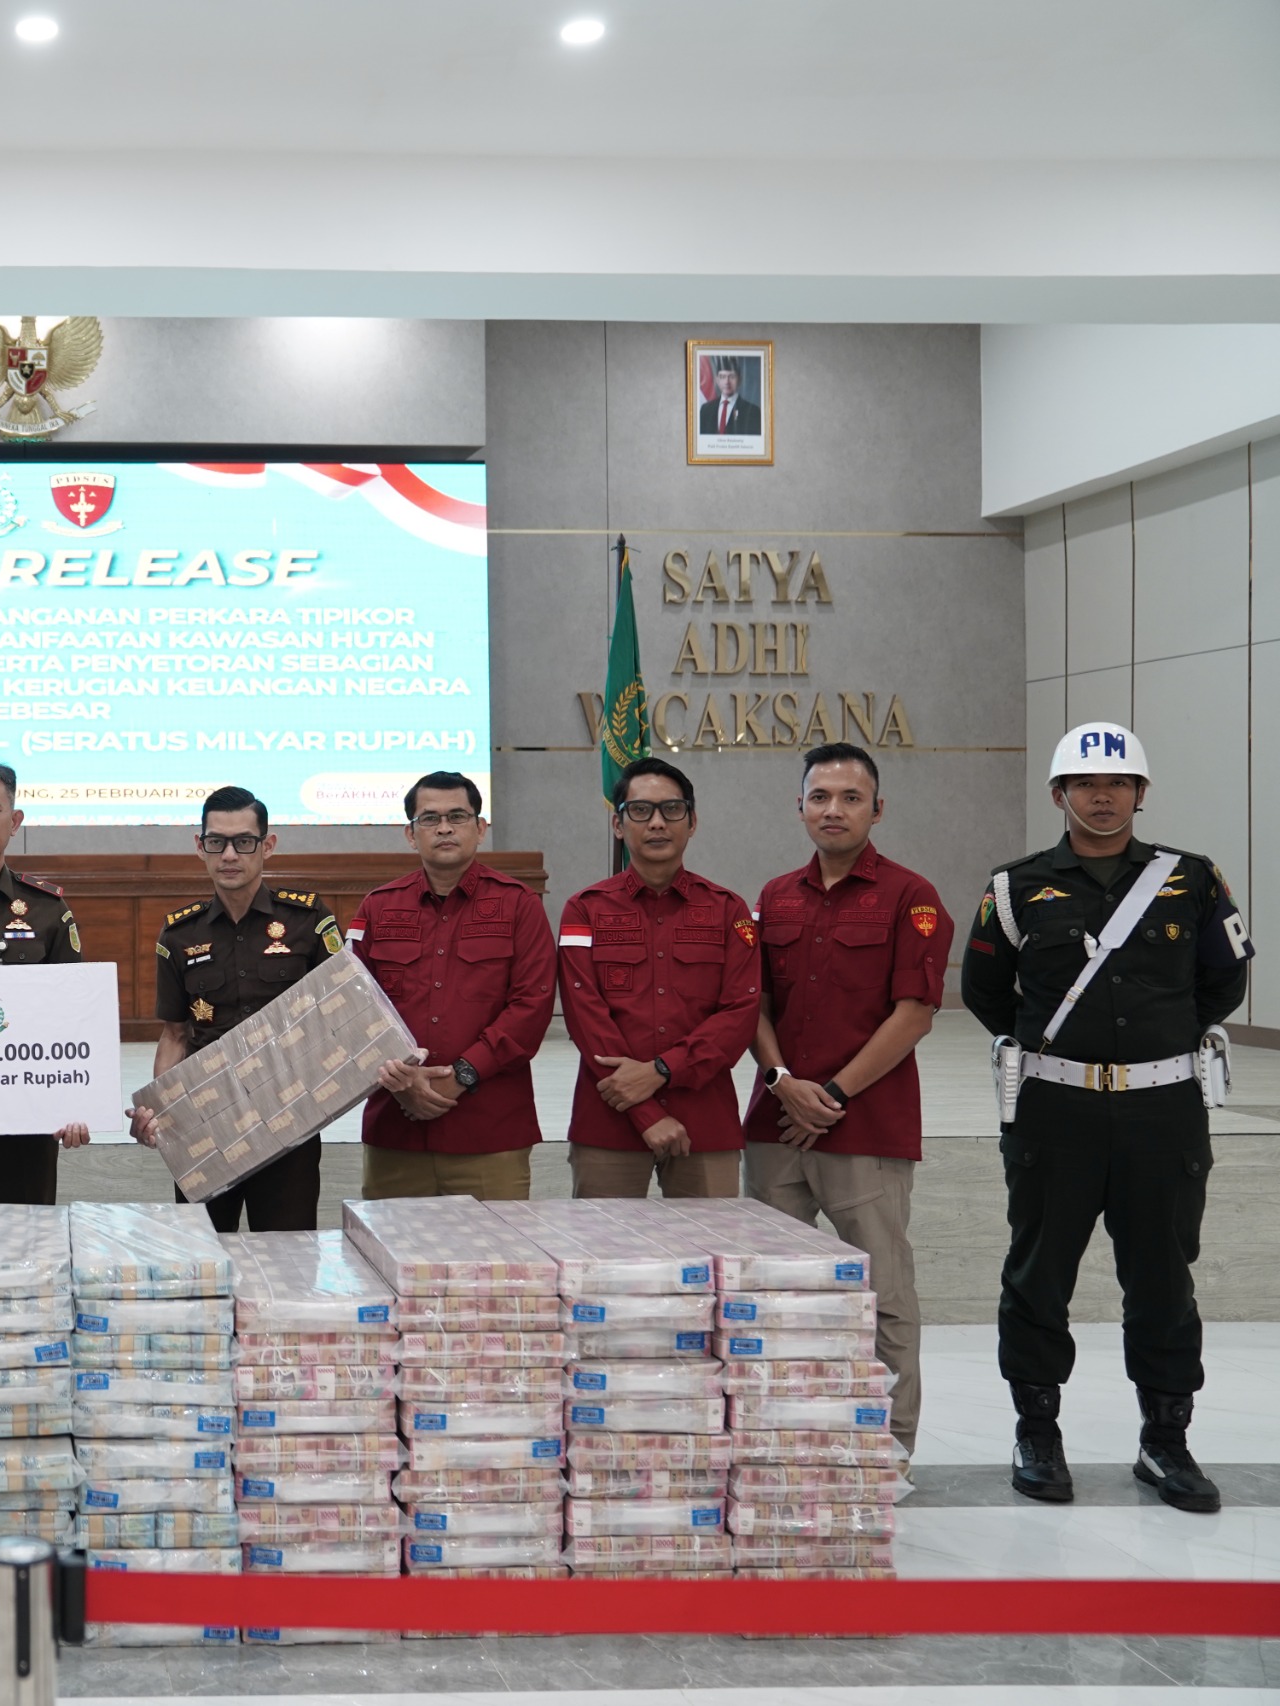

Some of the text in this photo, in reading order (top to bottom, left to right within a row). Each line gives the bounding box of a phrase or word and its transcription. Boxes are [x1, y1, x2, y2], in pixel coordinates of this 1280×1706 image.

[663, 550, 833, 604] SATYA
[148, 607, 290, 626] PERKARA
[296, 607, 415, 625] TIPIKOR
[168, 631, 322, 649] KAWASAN
[330, 630, 435, 648] HUTAN
[672, 621, 810, 676] ADHI
[71, 654, 275, 673] PENYETORAN
[281, 654, 434, 672] SEBAGIAN
[3, 679, 159, 696] KERUGIAN
[167, 678, 338, 696] KEUANGAN
[345, 677, 471, 696] NEGARA
[22, 729, 189, 756] (SERATUS
[197, 731, 326, 751] MILYAR
[334, 729, 477, 756] RUPIAH)
[1080, 731, 1127, 760] PM
[60, 788, 80, 798] 25
[86, 788, 179, 798] PEBRUARI
[601, 931, 624, 942] AGUS
[24, 1069, 90, 1089] Rupiah)
